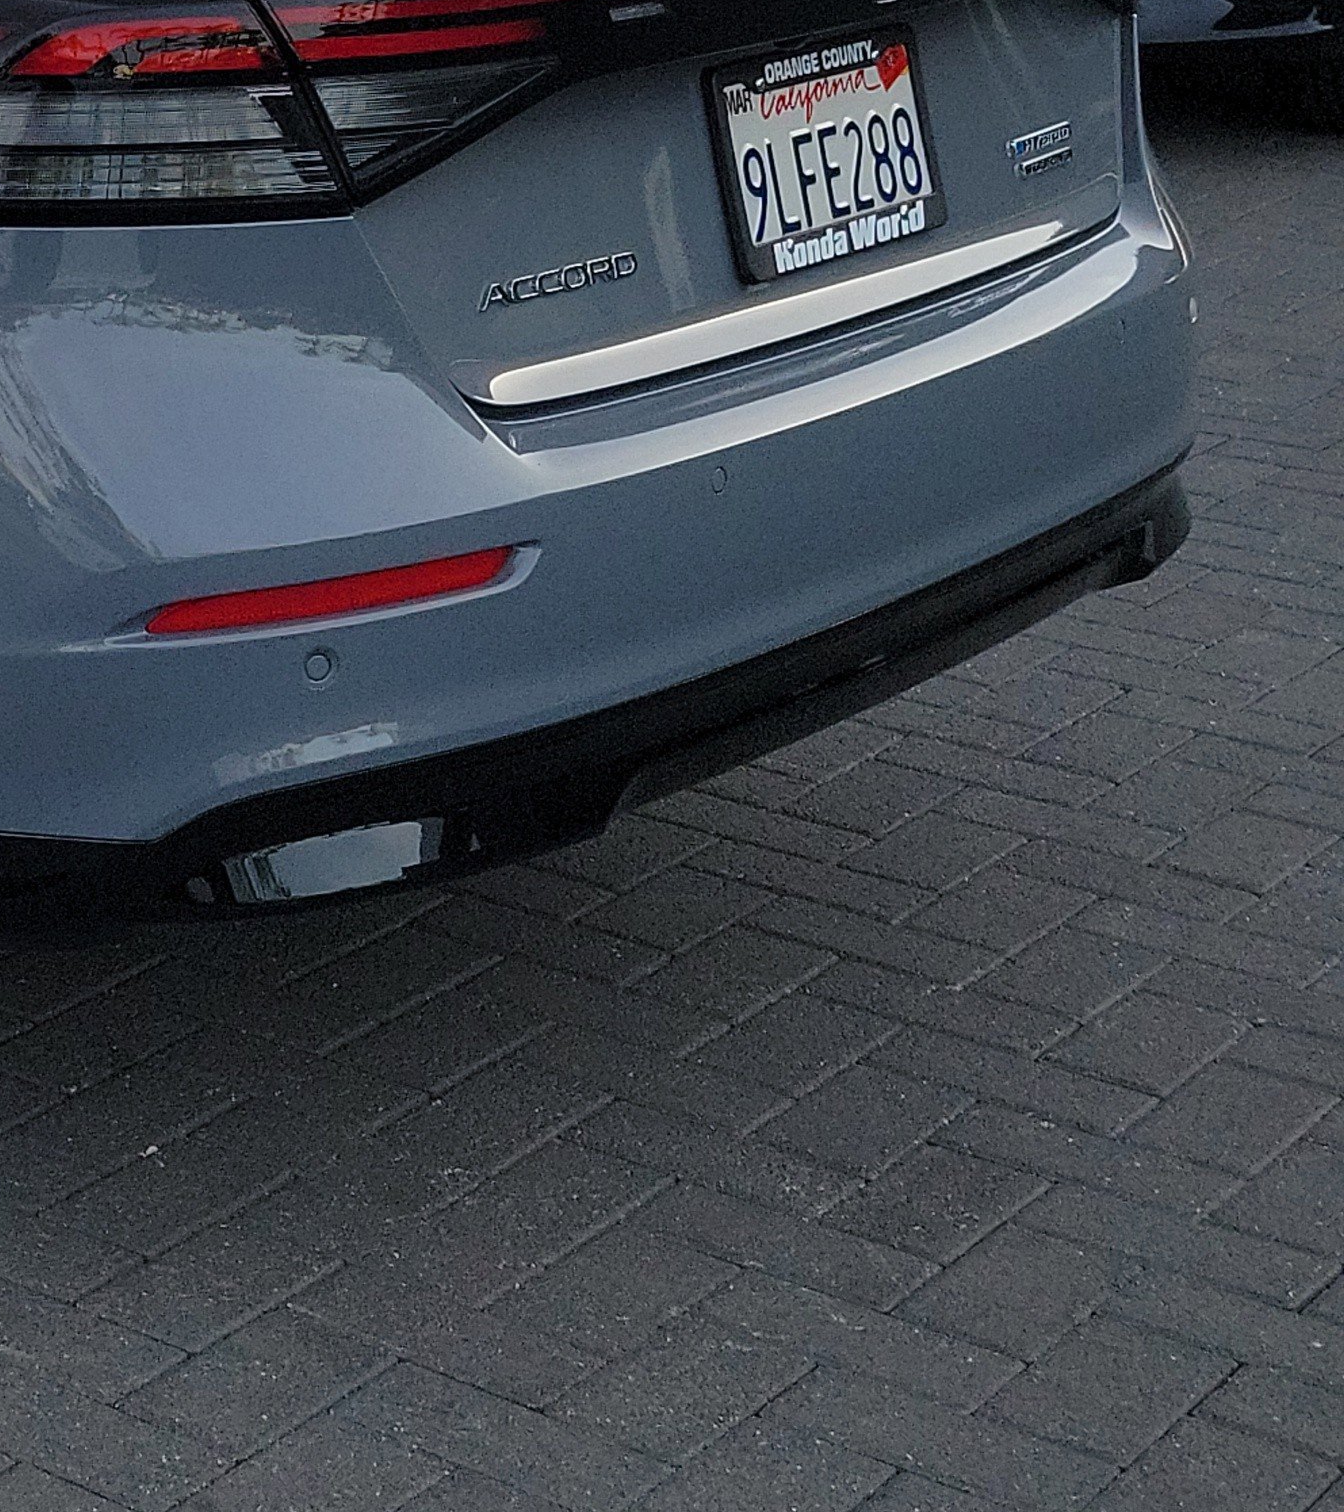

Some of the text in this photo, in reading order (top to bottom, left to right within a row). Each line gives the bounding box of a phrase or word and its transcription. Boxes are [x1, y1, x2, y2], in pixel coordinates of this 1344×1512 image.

[764, 50, 820, 85] ORANGE
[821, 39, 874, 70] COUNTY
[725, 90, 753, 116] MAR
[759, 69, 881, 124] California
[743, 104, 923, 243] 9LFE288
[478, 251, 638, 313] ACCORD
